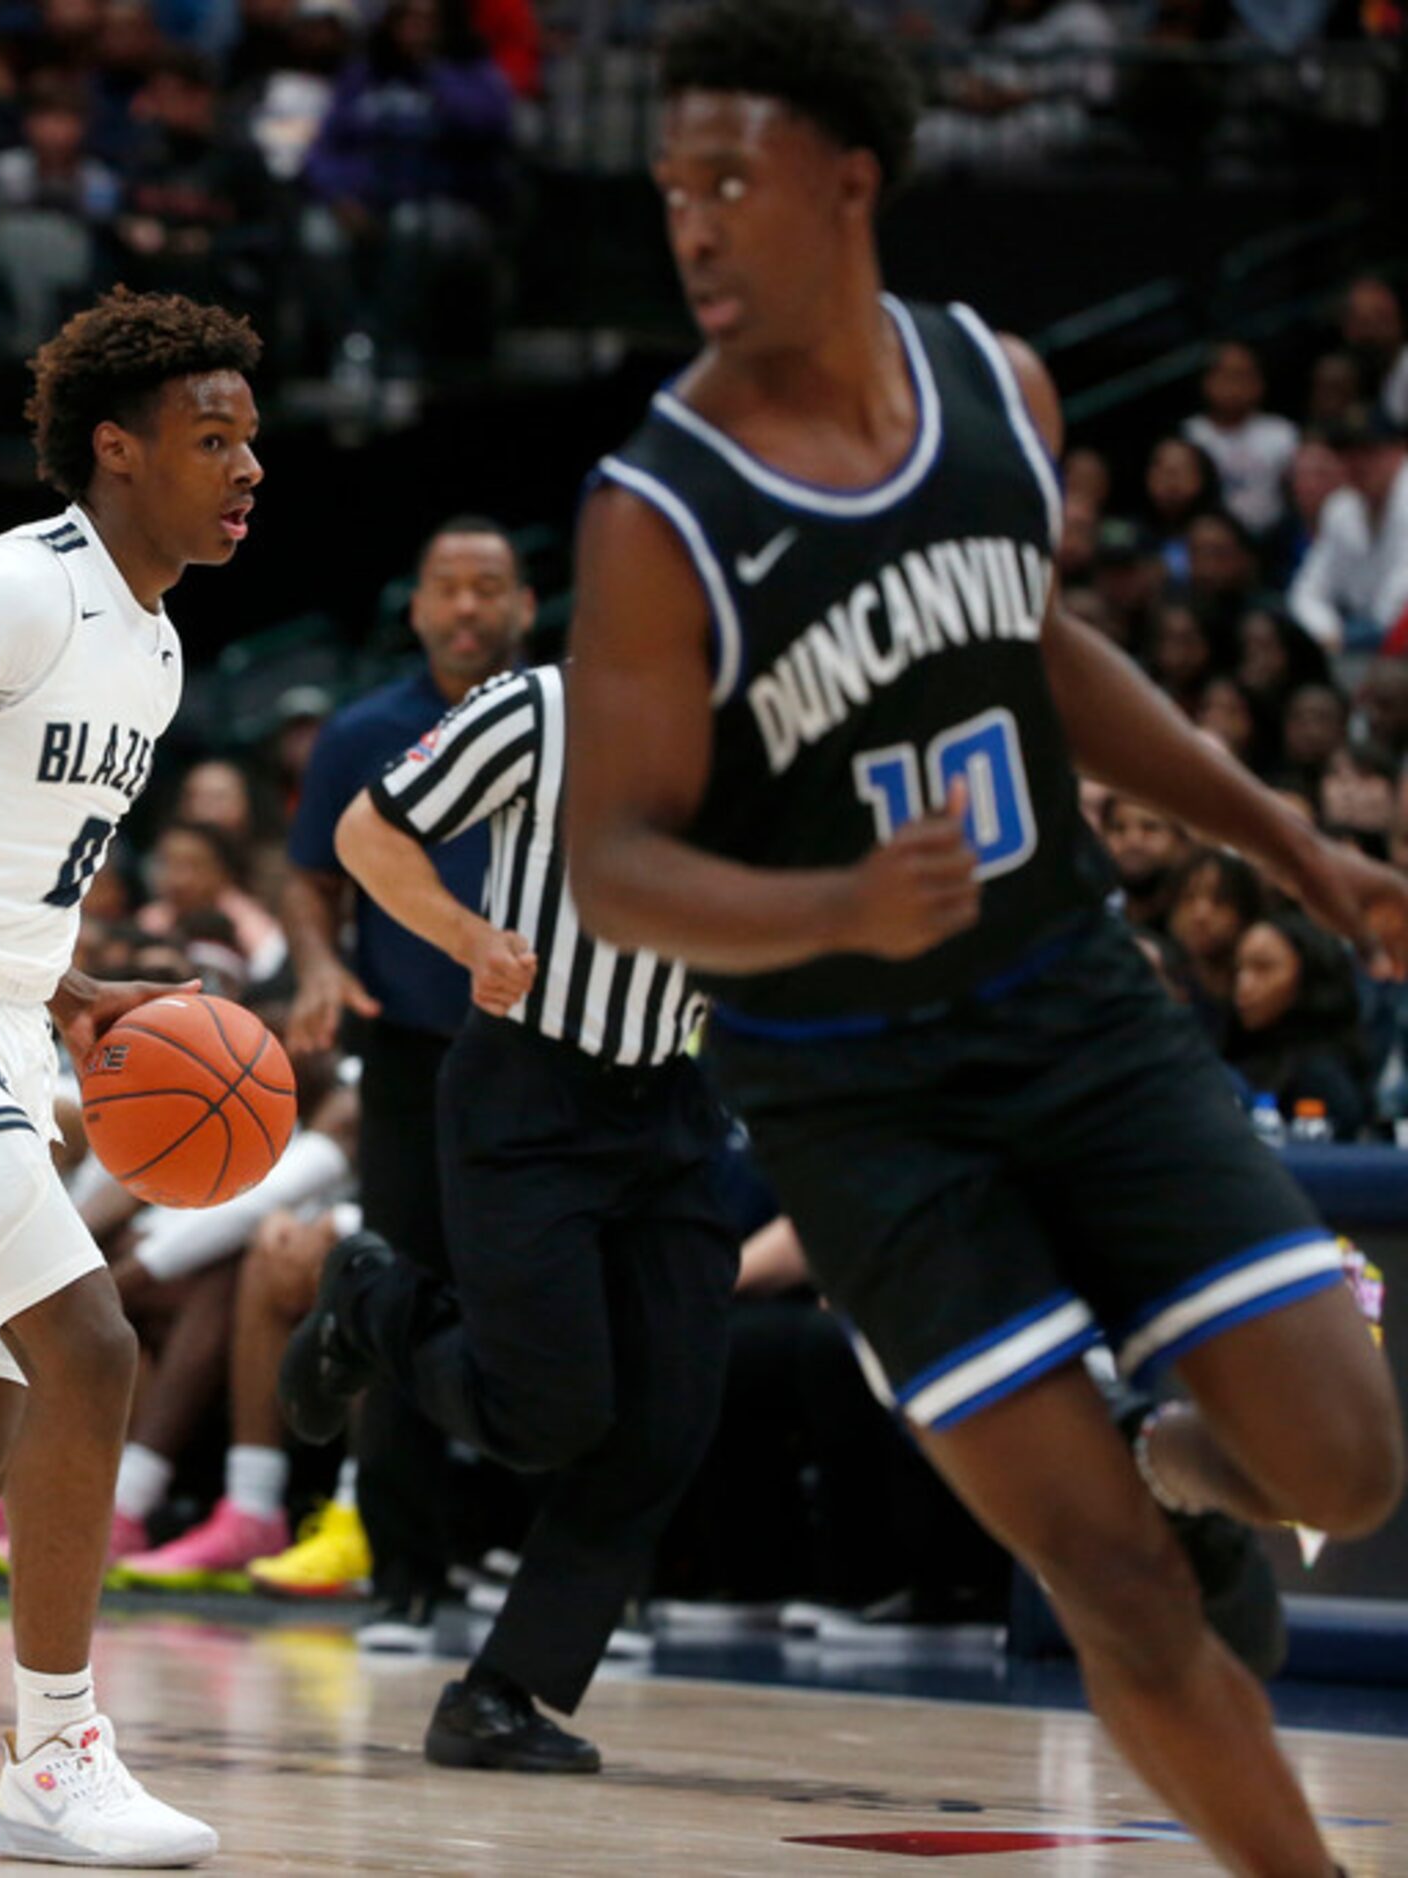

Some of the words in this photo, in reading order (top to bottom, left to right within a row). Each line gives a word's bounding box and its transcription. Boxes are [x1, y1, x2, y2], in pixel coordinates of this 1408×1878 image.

[747, 537, 1052, 776] DUNCANVILL
[41, 815, 112, 908] 0
[852, 706, 1038, 882] 10
